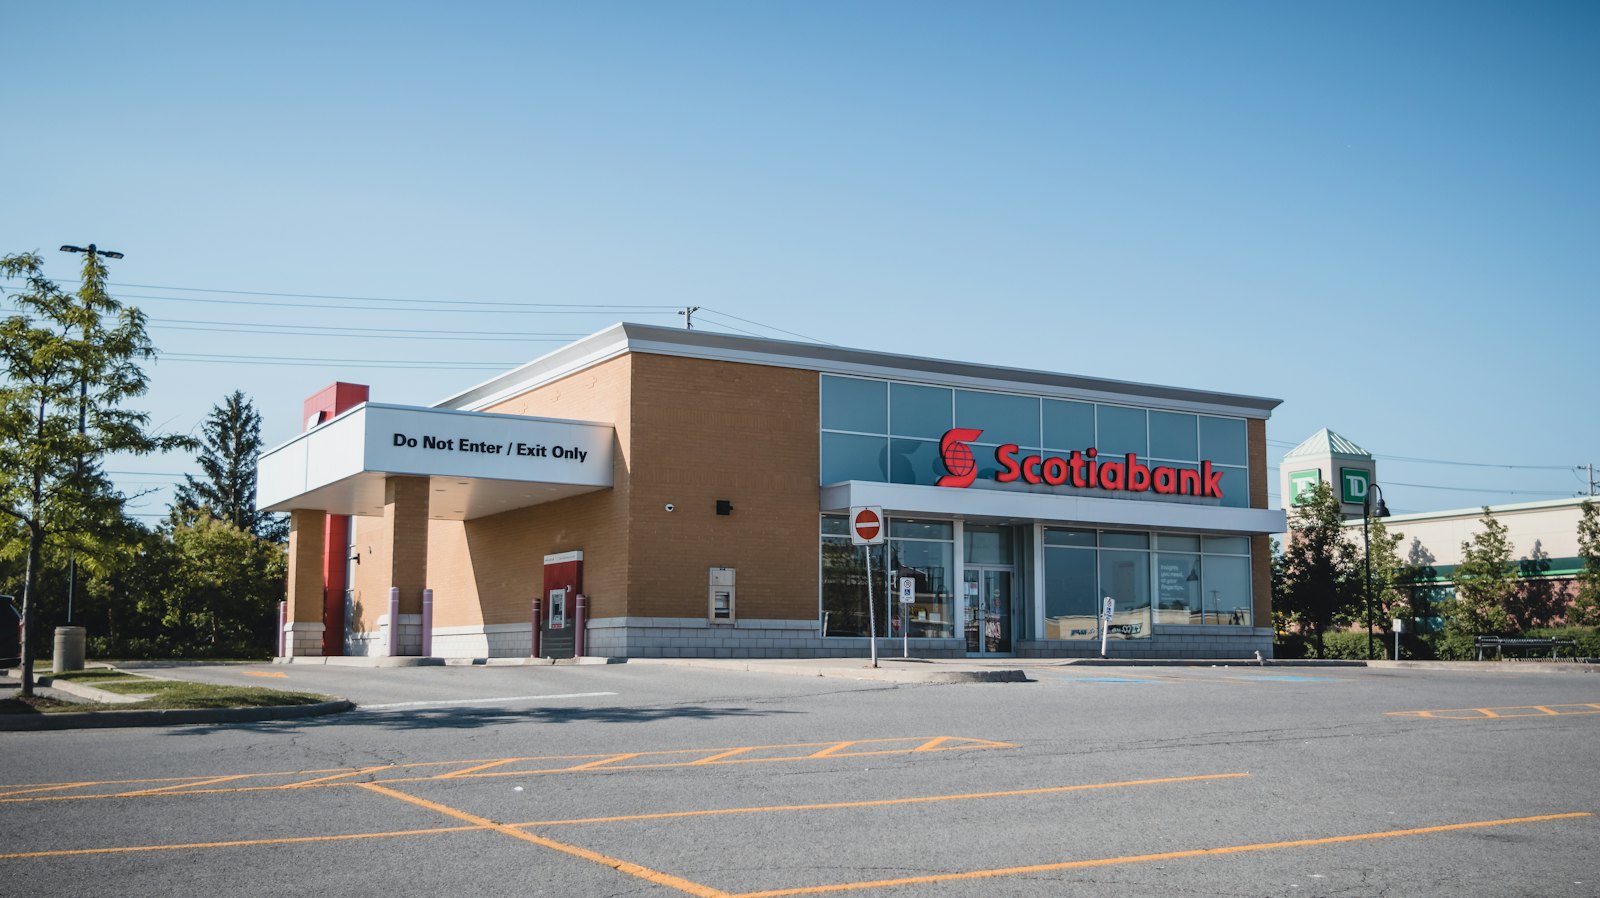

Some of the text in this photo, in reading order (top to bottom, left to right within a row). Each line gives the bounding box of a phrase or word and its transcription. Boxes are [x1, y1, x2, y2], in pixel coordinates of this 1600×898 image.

[393, 433, 588, 463] Do Not Enter / Exit Only
[995, 444, 1224, 498] Scotiabank
[1345, 475, 1368, 497] TD
